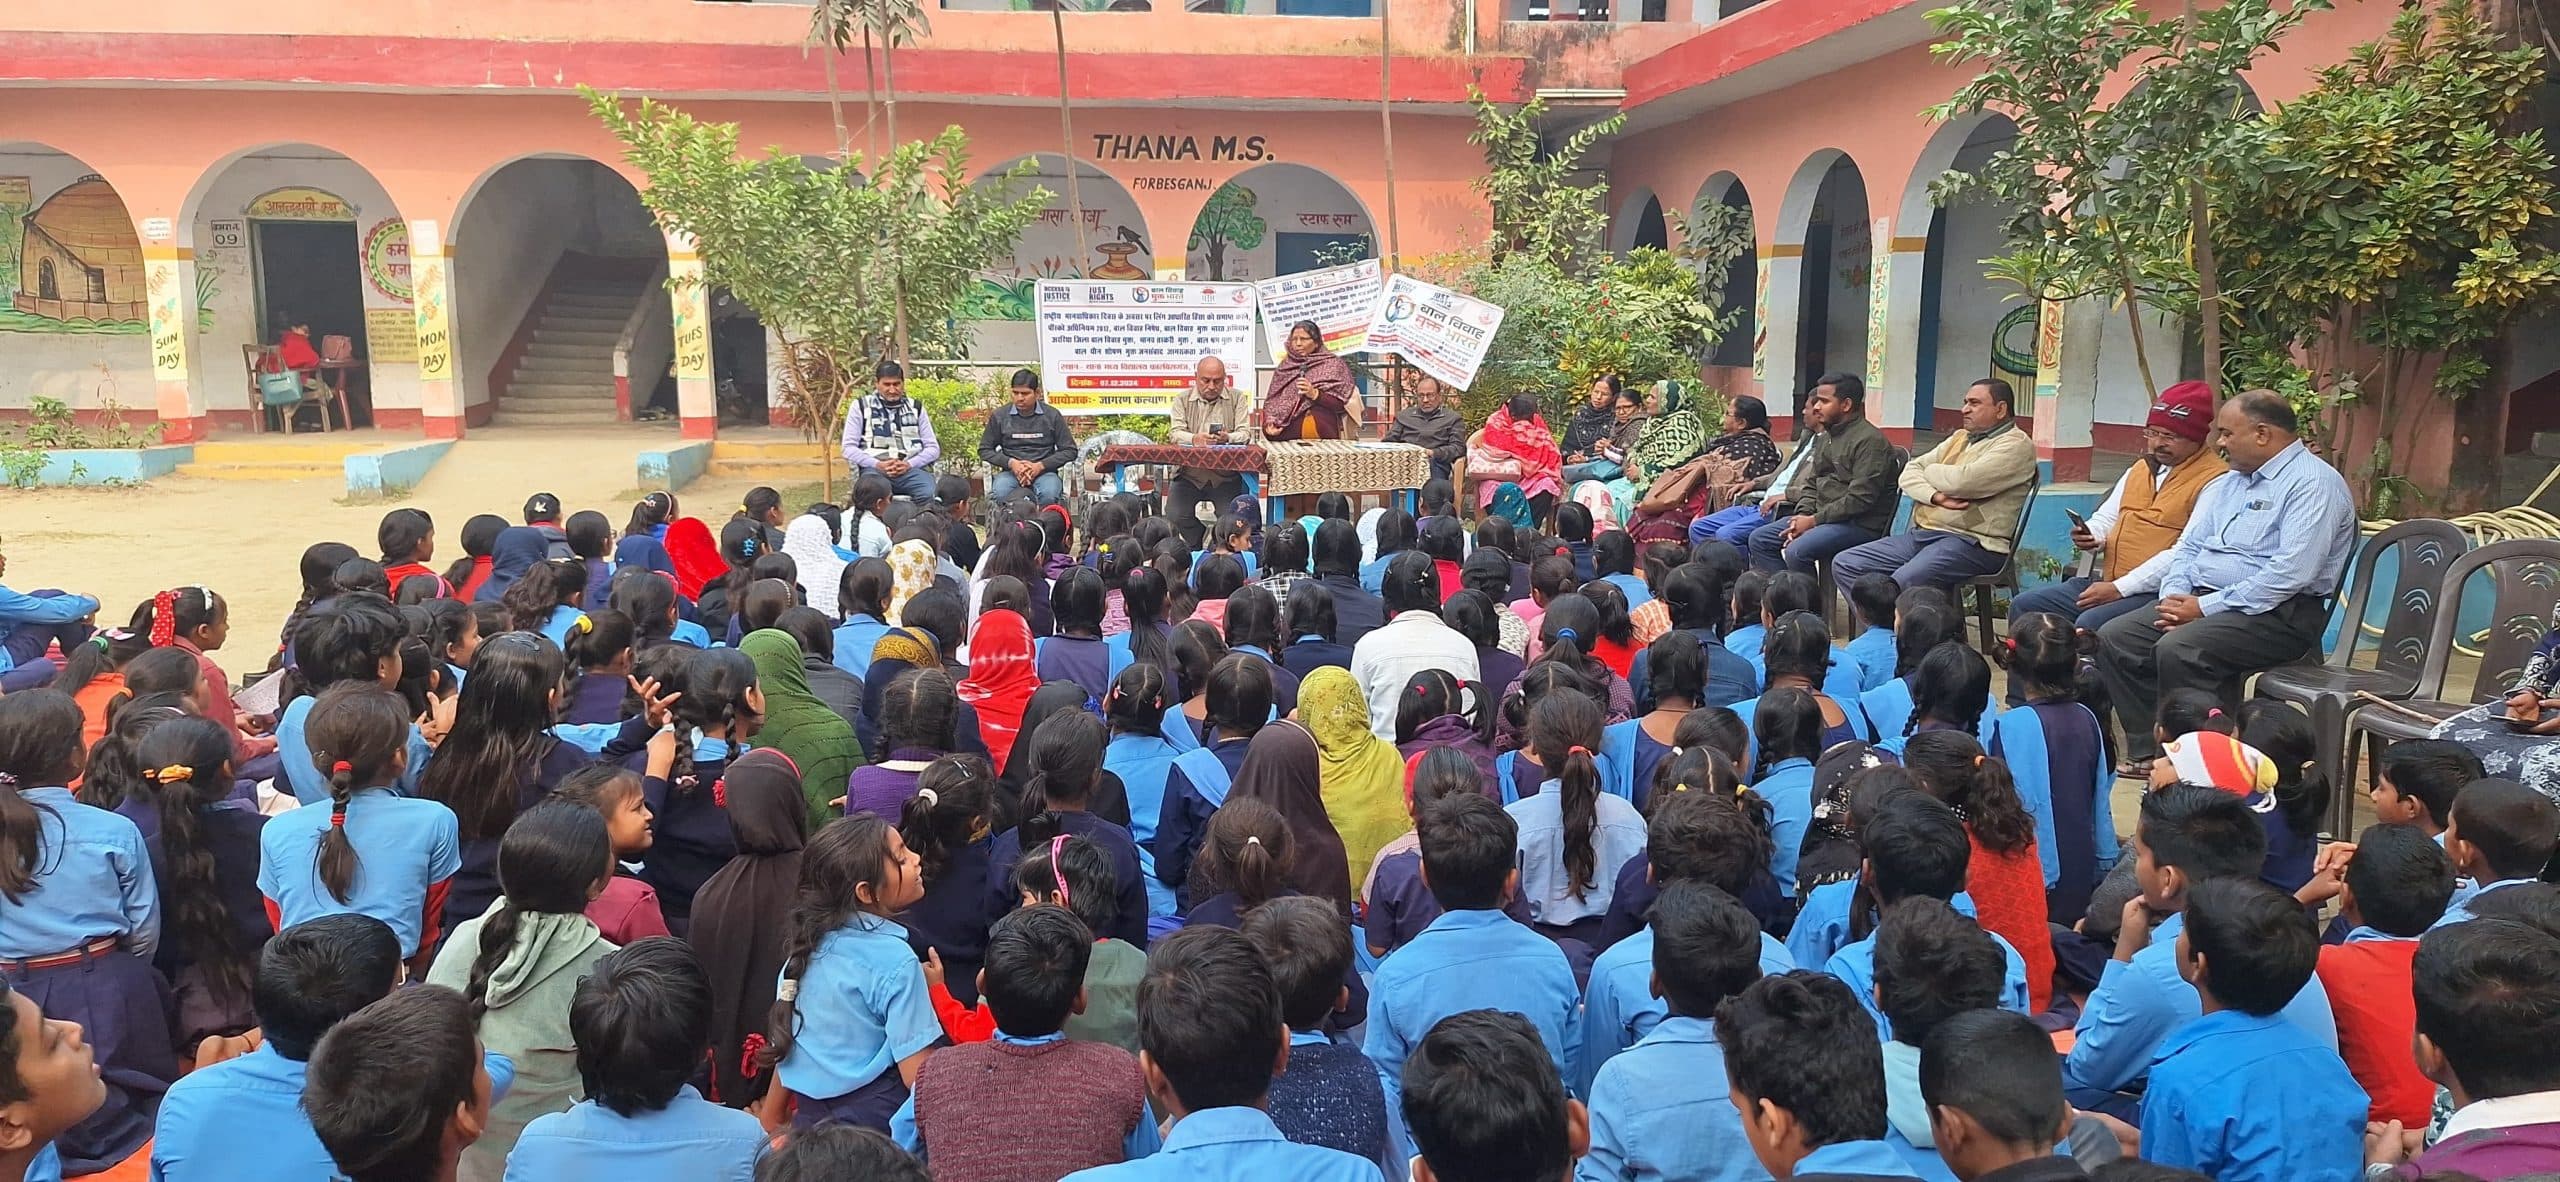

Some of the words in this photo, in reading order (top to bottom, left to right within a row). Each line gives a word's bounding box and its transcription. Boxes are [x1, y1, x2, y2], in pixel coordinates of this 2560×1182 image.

[1093, 134, 1201, 161] THANA
[1211, 135, 1274, 161] M.S.
[215, 233, 238, 245] 09
[1044, 292, 1070, 302] JUSTICE
[1089, 286, 1106, 294] JUST
[1089, 293, 1114, 301] RIGHTS
[1420, 303, 1447, 323] बाल
[1448, 315, 1485, 340] विवाह
[156, 332, 178, 349] SUN
[420, 330, 446, 348] MON
[678, 325, 703, 348] TUES
[158, 352, 180, 370] DAY
[423, 352, 446, 373] DAY
[681, 352, 705, 371] DAY
